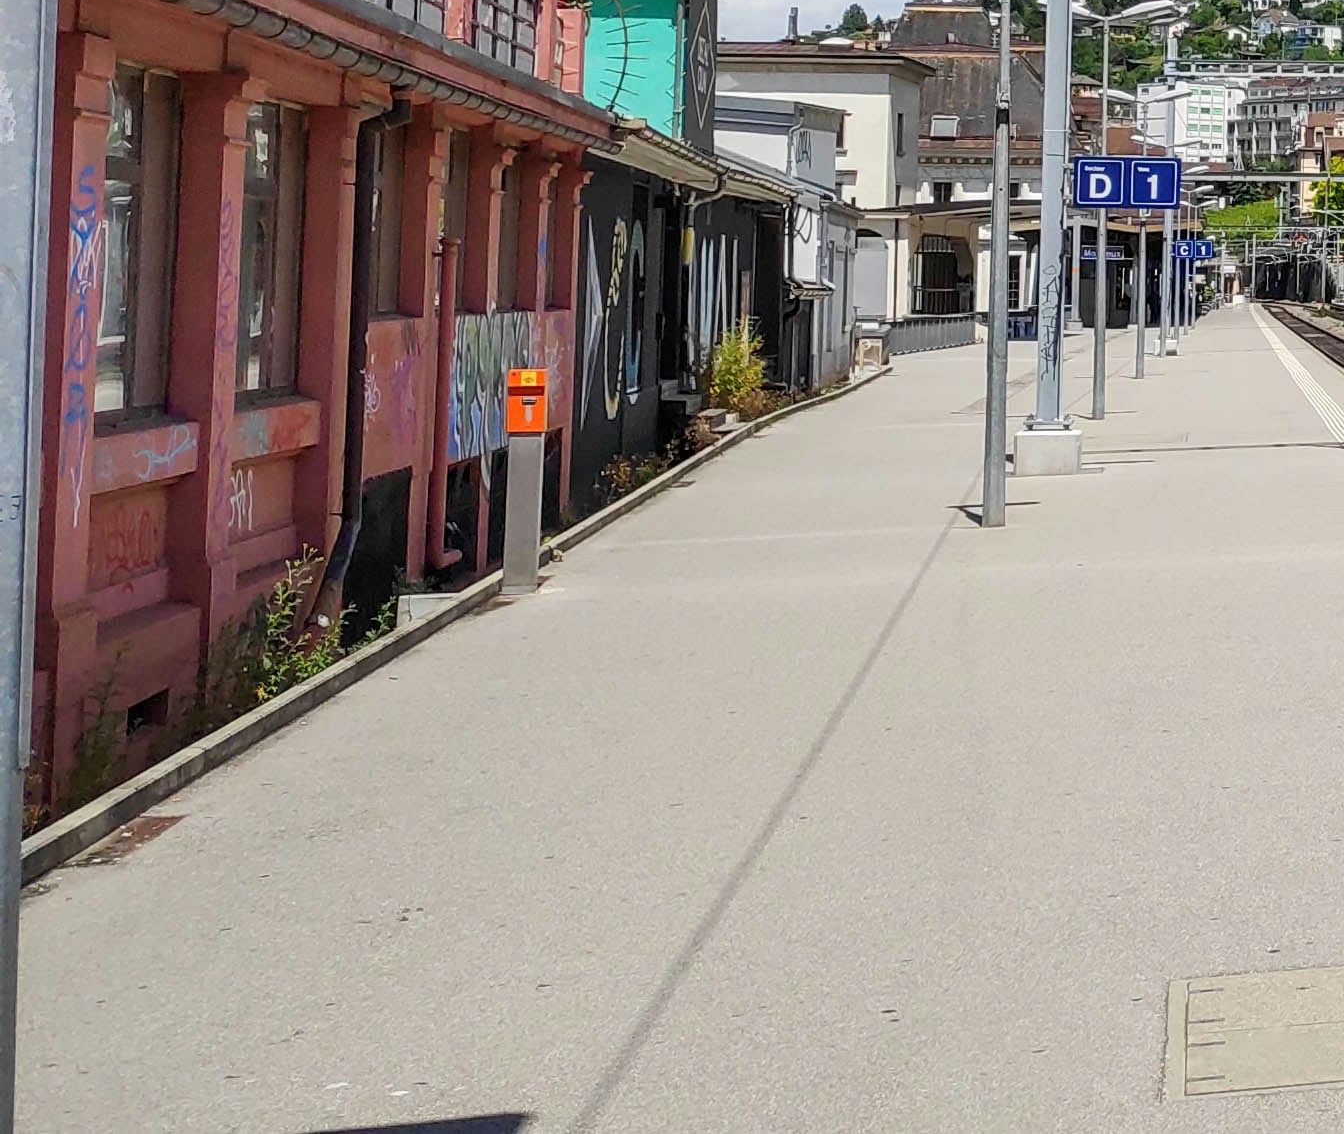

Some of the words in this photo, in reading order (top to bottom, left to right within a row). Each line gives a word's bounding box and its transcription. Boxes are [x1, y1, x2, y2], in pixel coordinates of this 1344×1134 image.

[1089, 173, 1112, 199] D
[1146, 174, 1158, 199] 1
[1180, 245, 1189, 256] C
[1200, 245, 1206, 256] 1
